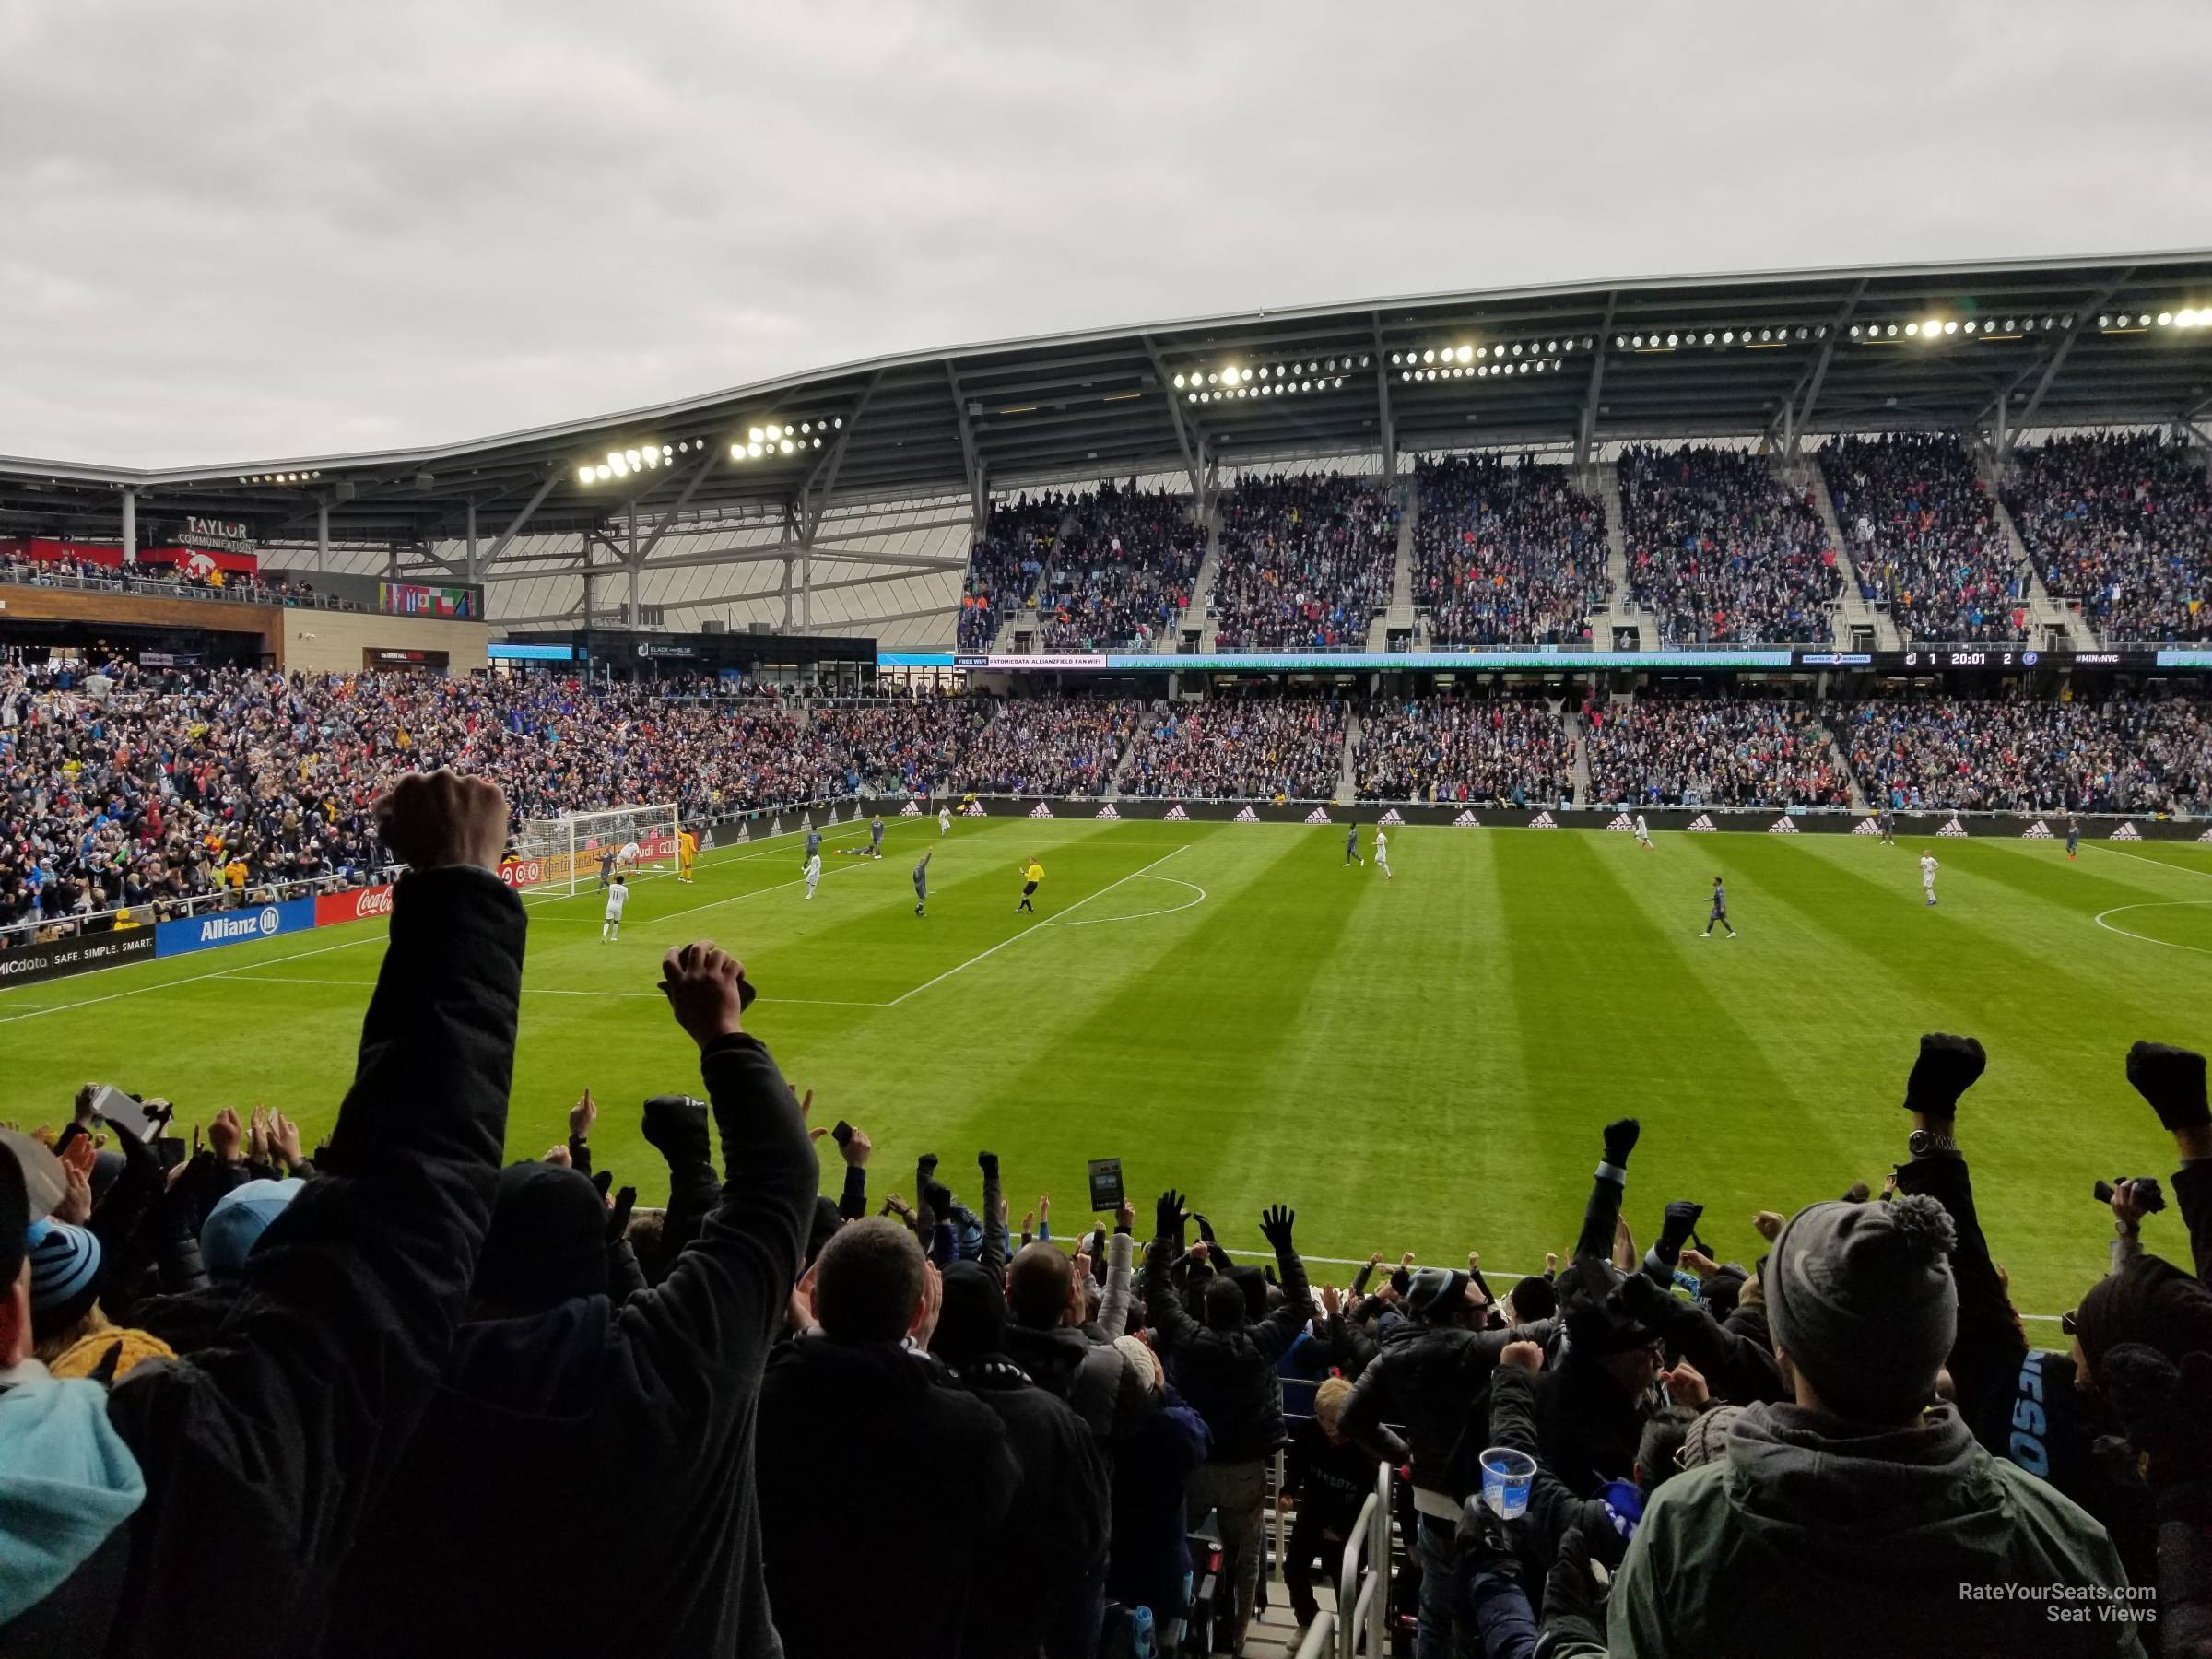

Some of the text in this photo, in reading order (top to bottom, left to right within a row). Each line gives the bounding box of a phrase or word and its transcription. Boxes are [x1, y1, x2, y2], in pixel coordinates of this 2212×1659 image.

[187, 516, 247, 539] TAYLOR
[179, 534, 255, 552] COMMUNICATIONS
[1929, 653, 1936, 665] 1
[1951, 653, 1985, 665] 20:01
[2004, 653, 2011, 665] 2
[640, 845, 653, 857] udi
[200, 916, 257, 941] Allianz
[53, 950, 81, 965] SAFE.
[84, 944, 120, 959] SIMPLE.
